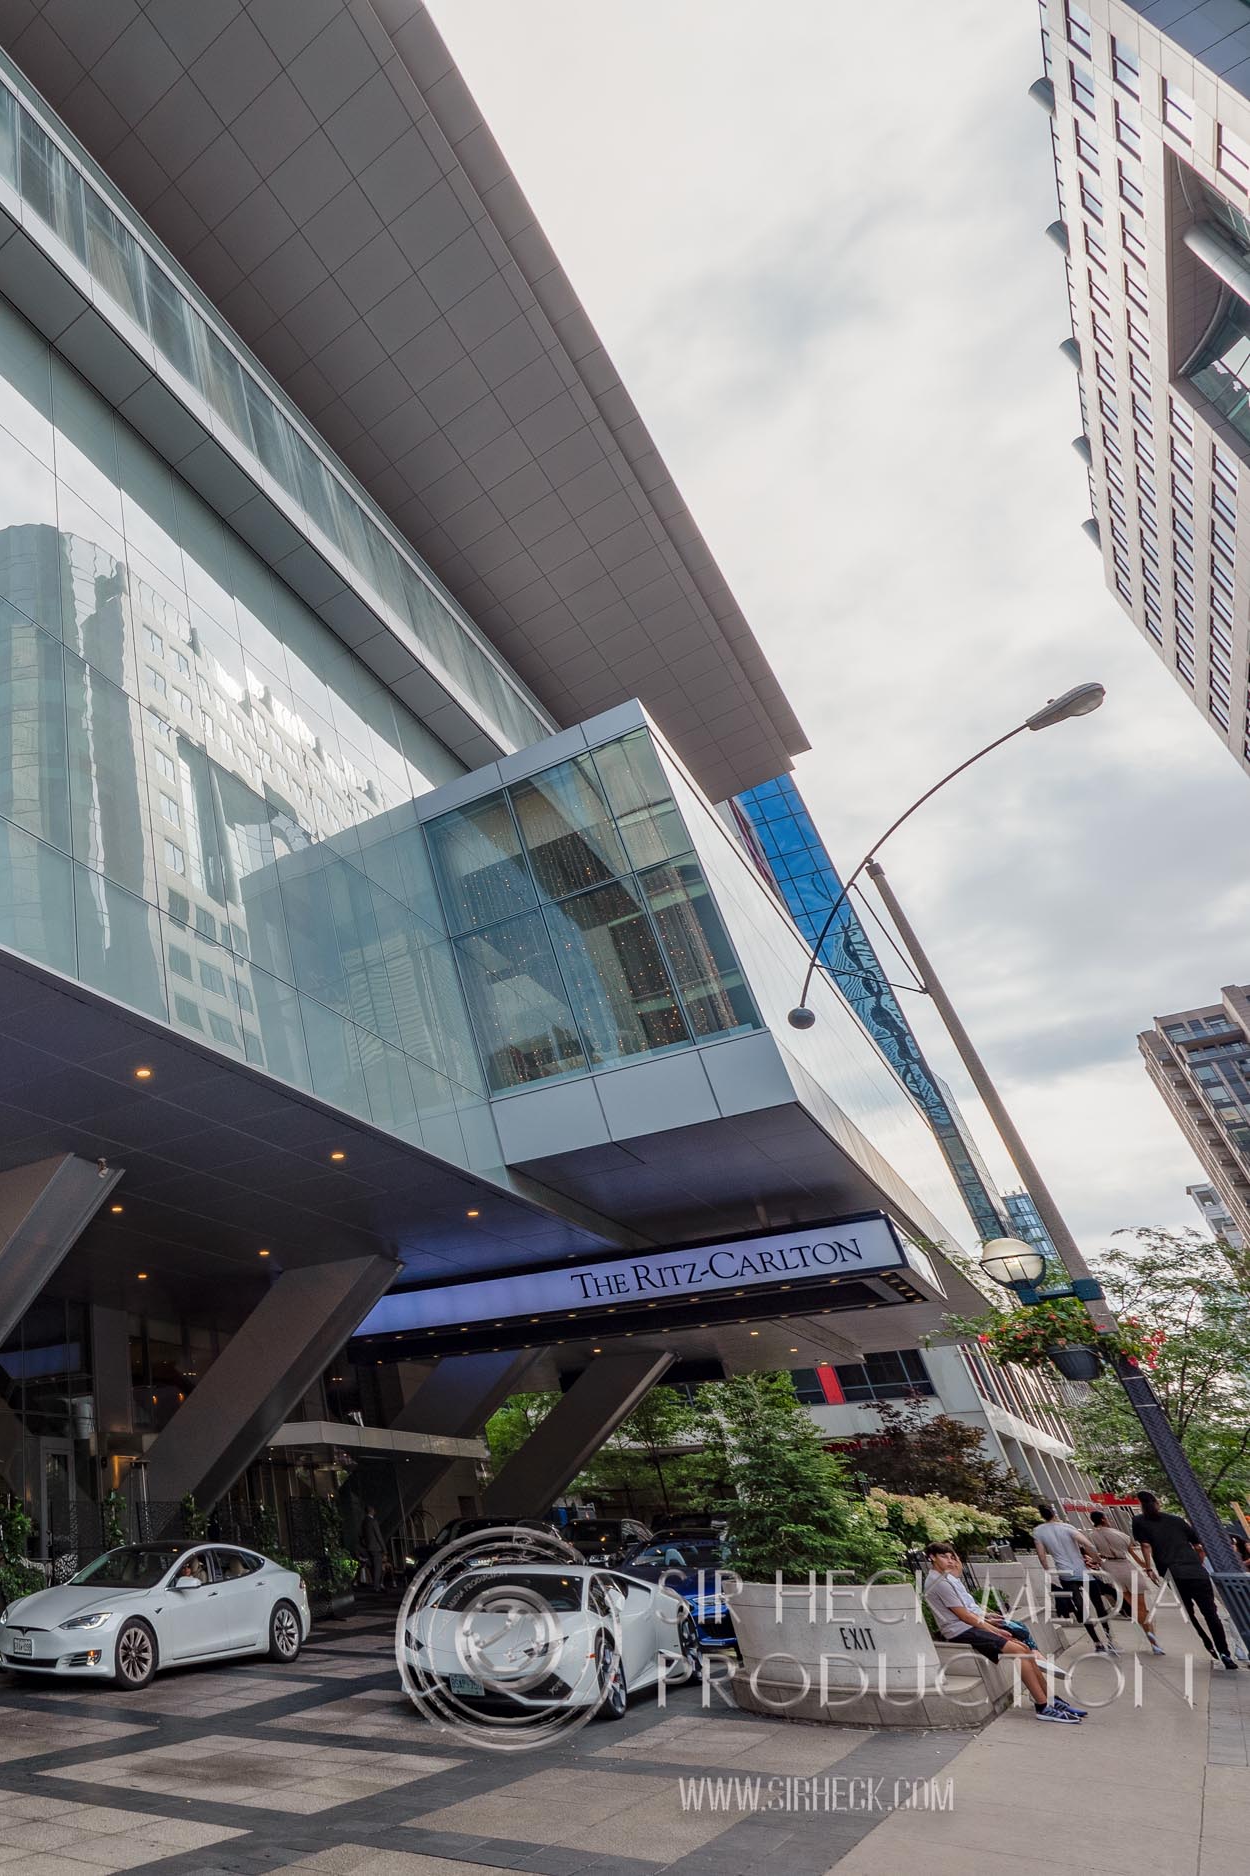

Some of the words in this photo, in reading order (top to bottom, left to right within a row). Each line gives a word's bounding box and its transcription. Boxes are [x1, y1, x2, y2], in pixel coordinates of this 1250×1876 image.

[570, 1272, 630, 1299] THE
[630, 1238, 863, 1291] RITZ-CARLTON
[840, 1627, 876, 1650] EXIT
